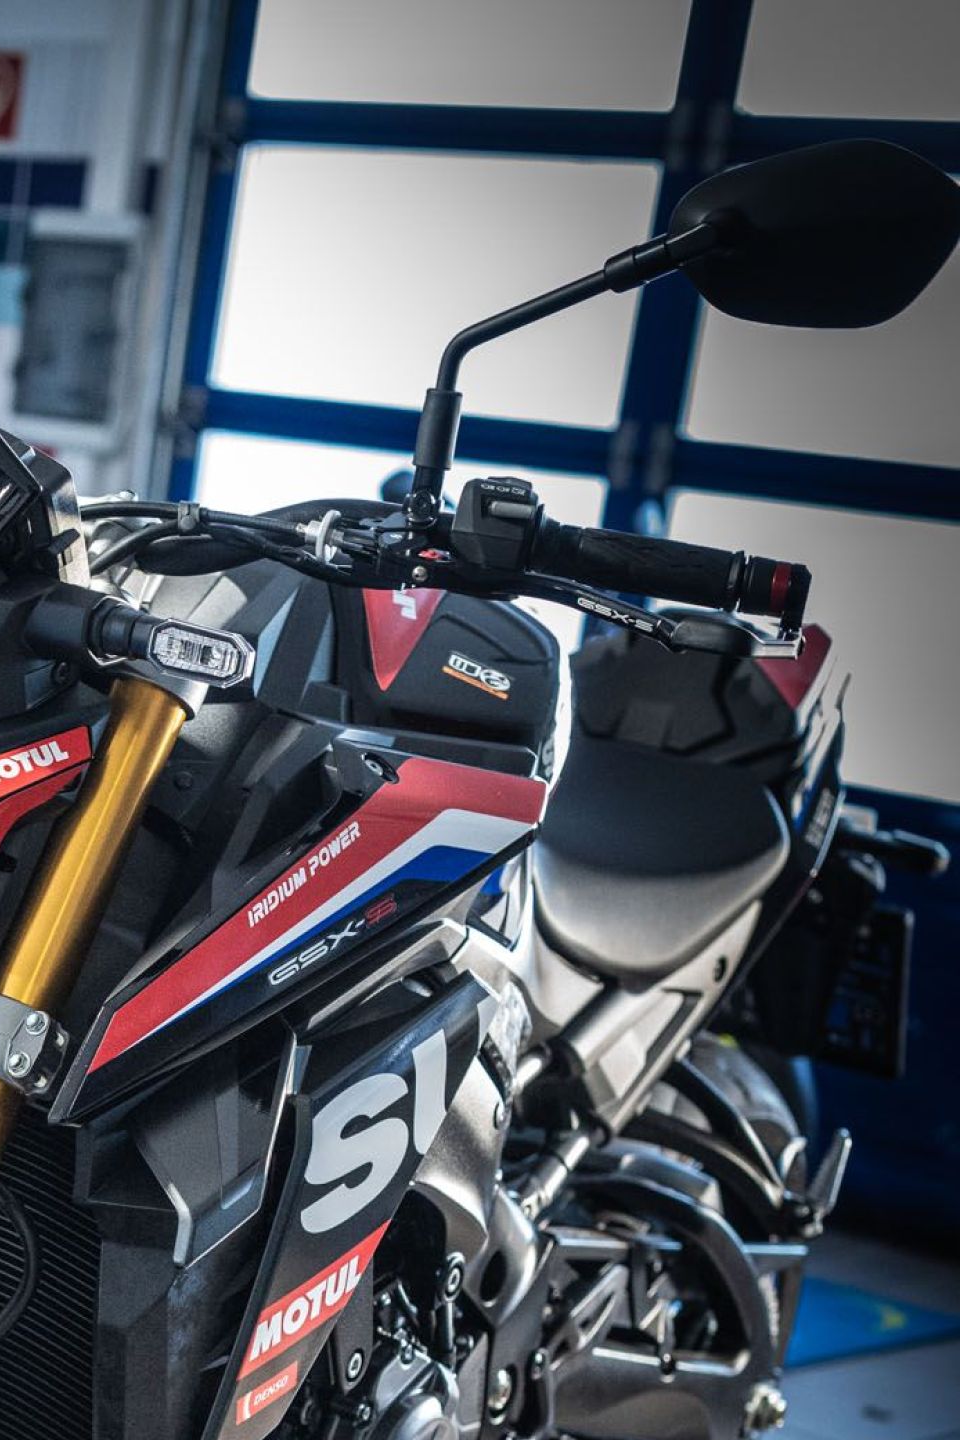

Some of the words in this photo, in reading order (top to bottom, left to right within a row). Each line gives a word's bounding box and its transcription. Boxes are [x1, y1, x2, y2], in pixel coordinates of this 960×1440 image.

[577, 597, 653, 633] GSX-S
[247, 867, 307, 928] IRIDIUM
[308, 821, 361, 877] POWER
[268, 895, 398, 985] GSX-S
[250, 1255, 362, 1361] MOTUL
[253, 1375, 289, 1406] DENSO
